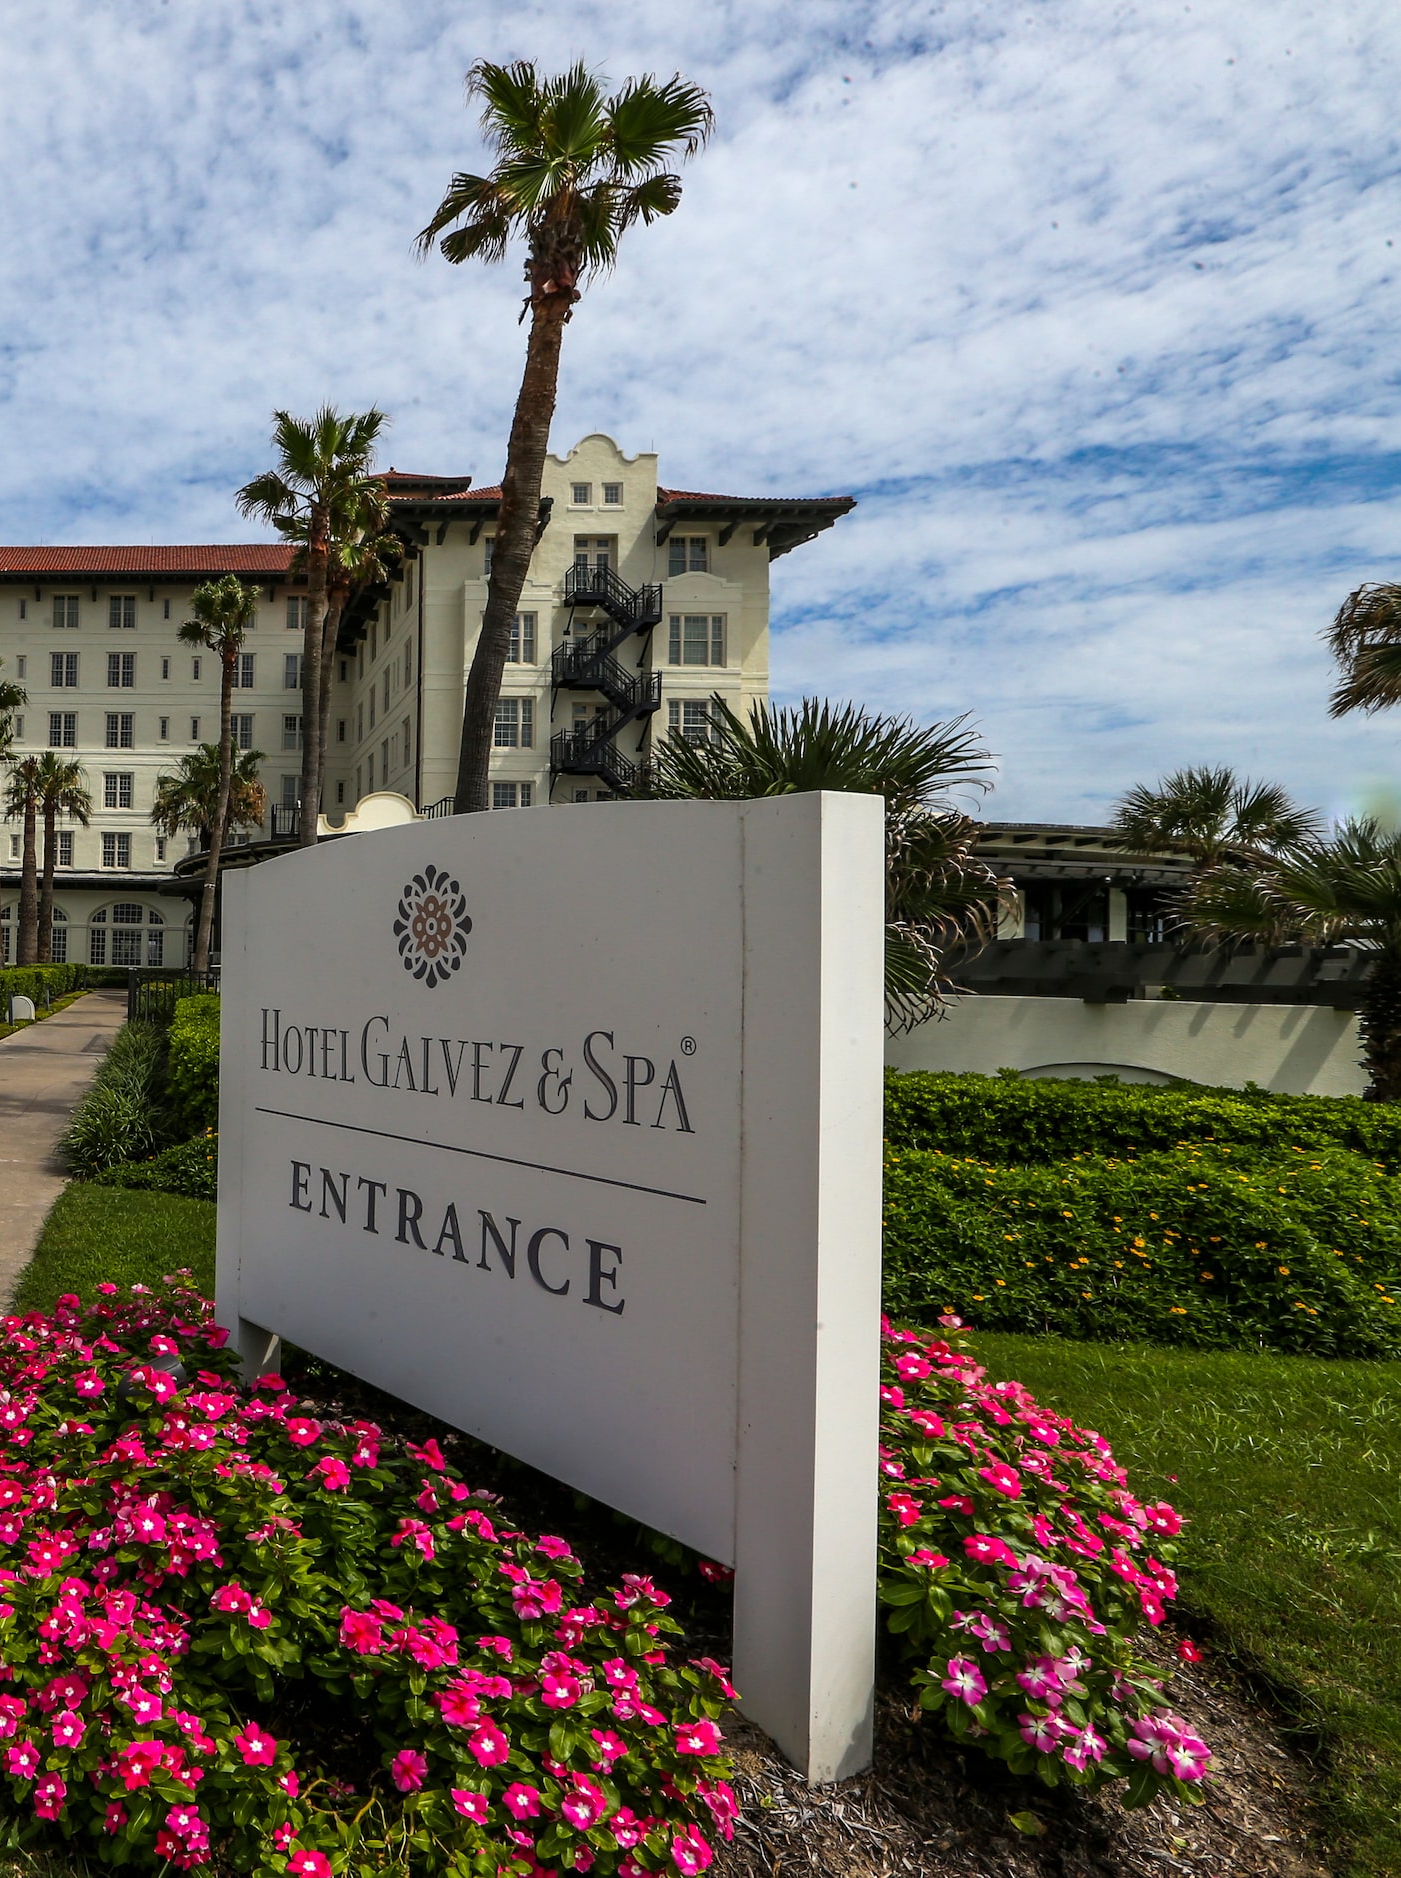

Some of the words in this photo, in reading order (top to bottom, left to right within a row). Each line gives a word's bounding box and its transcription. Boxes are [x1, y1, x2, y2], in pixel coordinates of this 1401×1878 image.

[260, 1008, 355, 1083] HOTEL
[360, 1016, 525, 1110] GALVEZ
[537, 1048, 573, 1115] &
[289, 1159, 626, 1316] ENTRANCE
